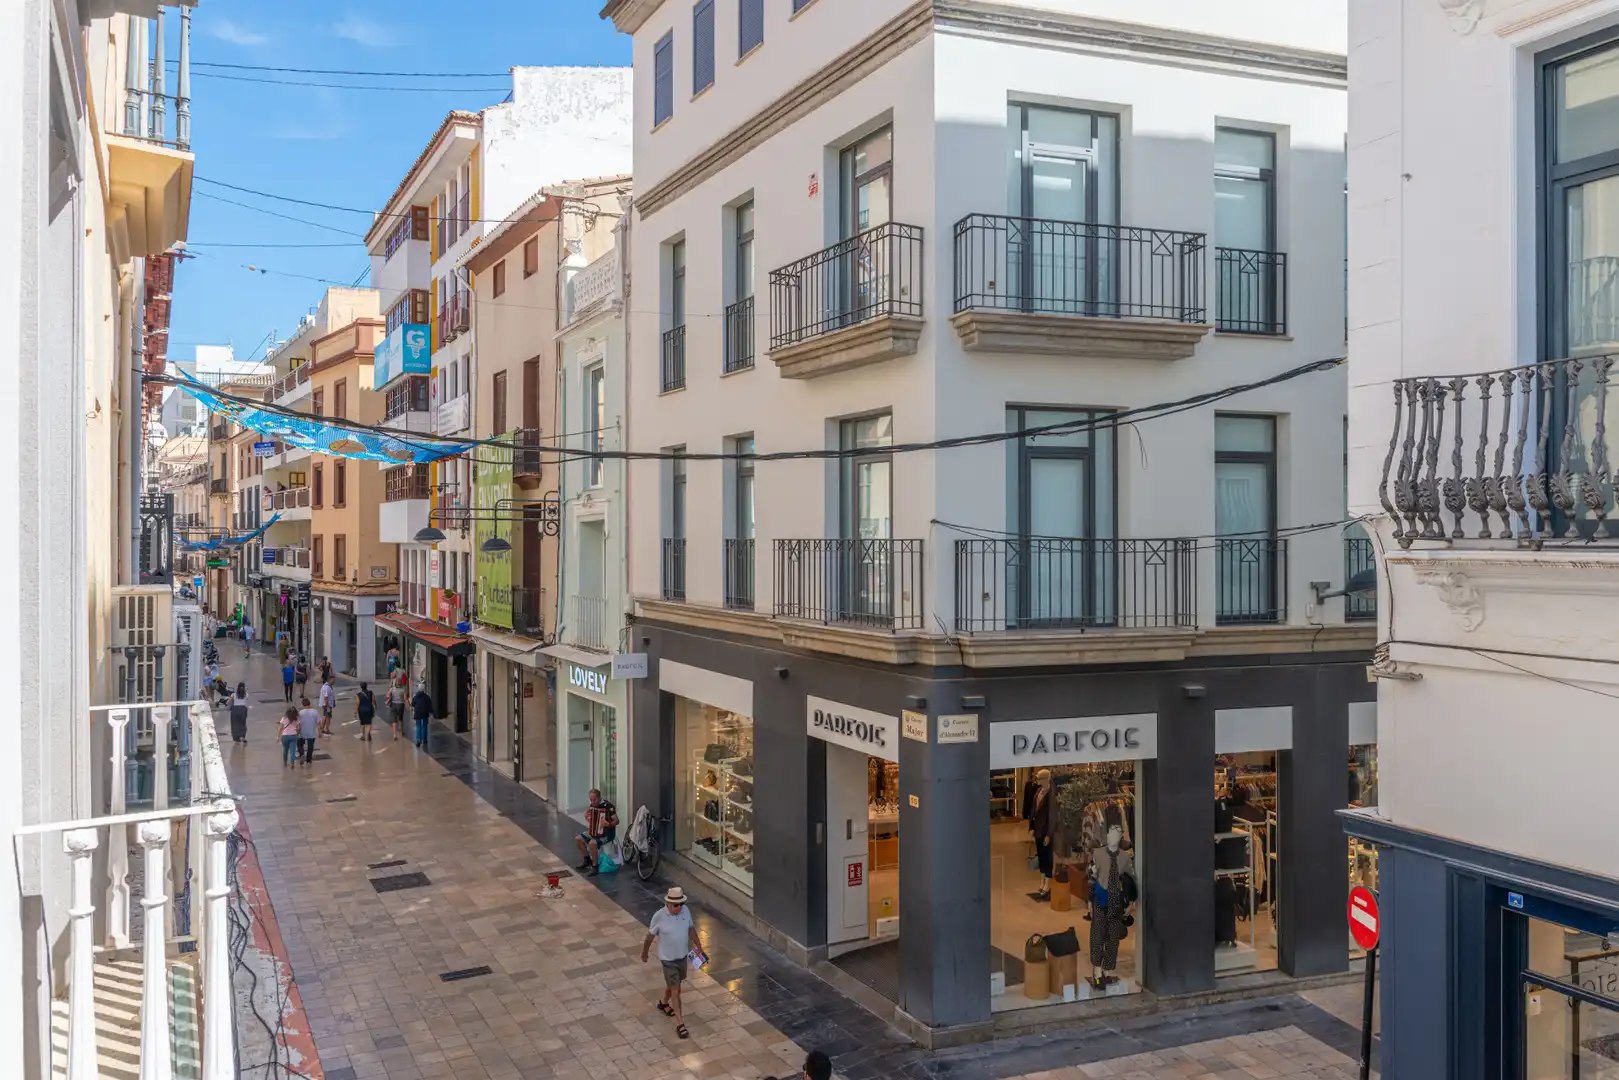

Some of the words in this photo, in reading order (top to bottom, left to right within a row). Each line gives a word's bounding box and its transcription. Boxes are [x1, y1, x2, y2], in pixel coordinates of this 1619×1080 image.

[569, 665, 607, 696] LOVELY
[813, 709, 886, 747] PARFOIS
[906, 725, 924, 737] Major
[1012, 727, 1141, 755] PARFOIS
